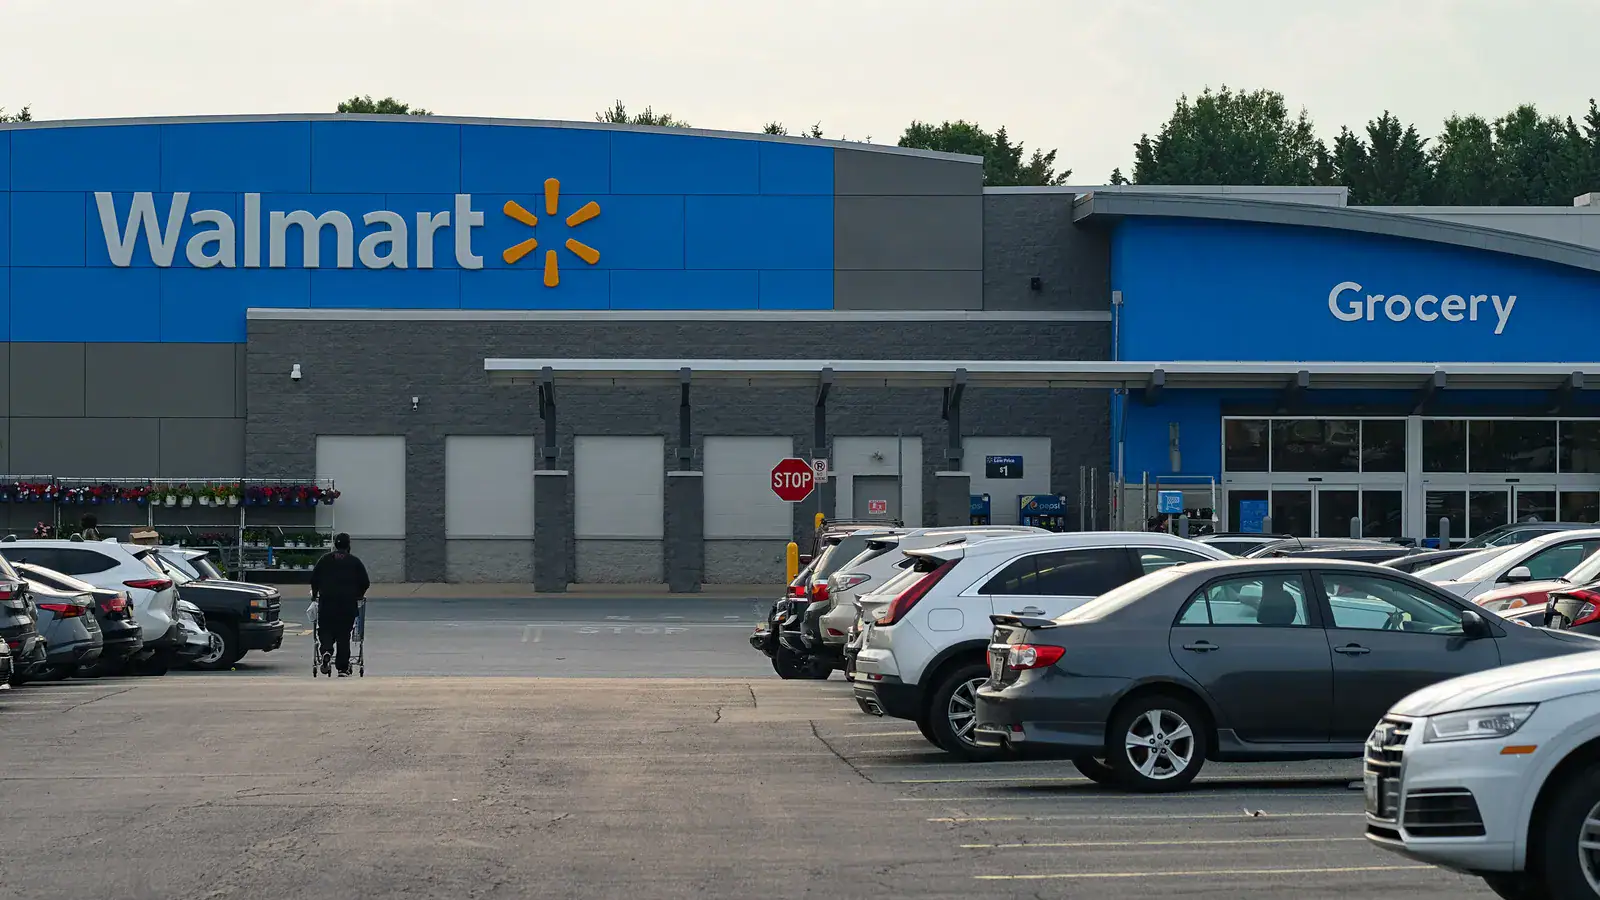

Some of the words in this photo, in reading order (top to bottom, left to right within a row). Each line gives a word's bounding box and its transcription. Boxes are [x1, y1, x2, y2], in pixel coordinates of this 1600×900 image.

[94, 191, 484, 269] Walmart
[1328, 281, 1517, 334] Grocery
[999, 465, 1008, 476] $1
[774, 472, 812, 488] STOP
[1039, 502, 1061, 511] pepsi
[576, 626, 690, 635] STOP
